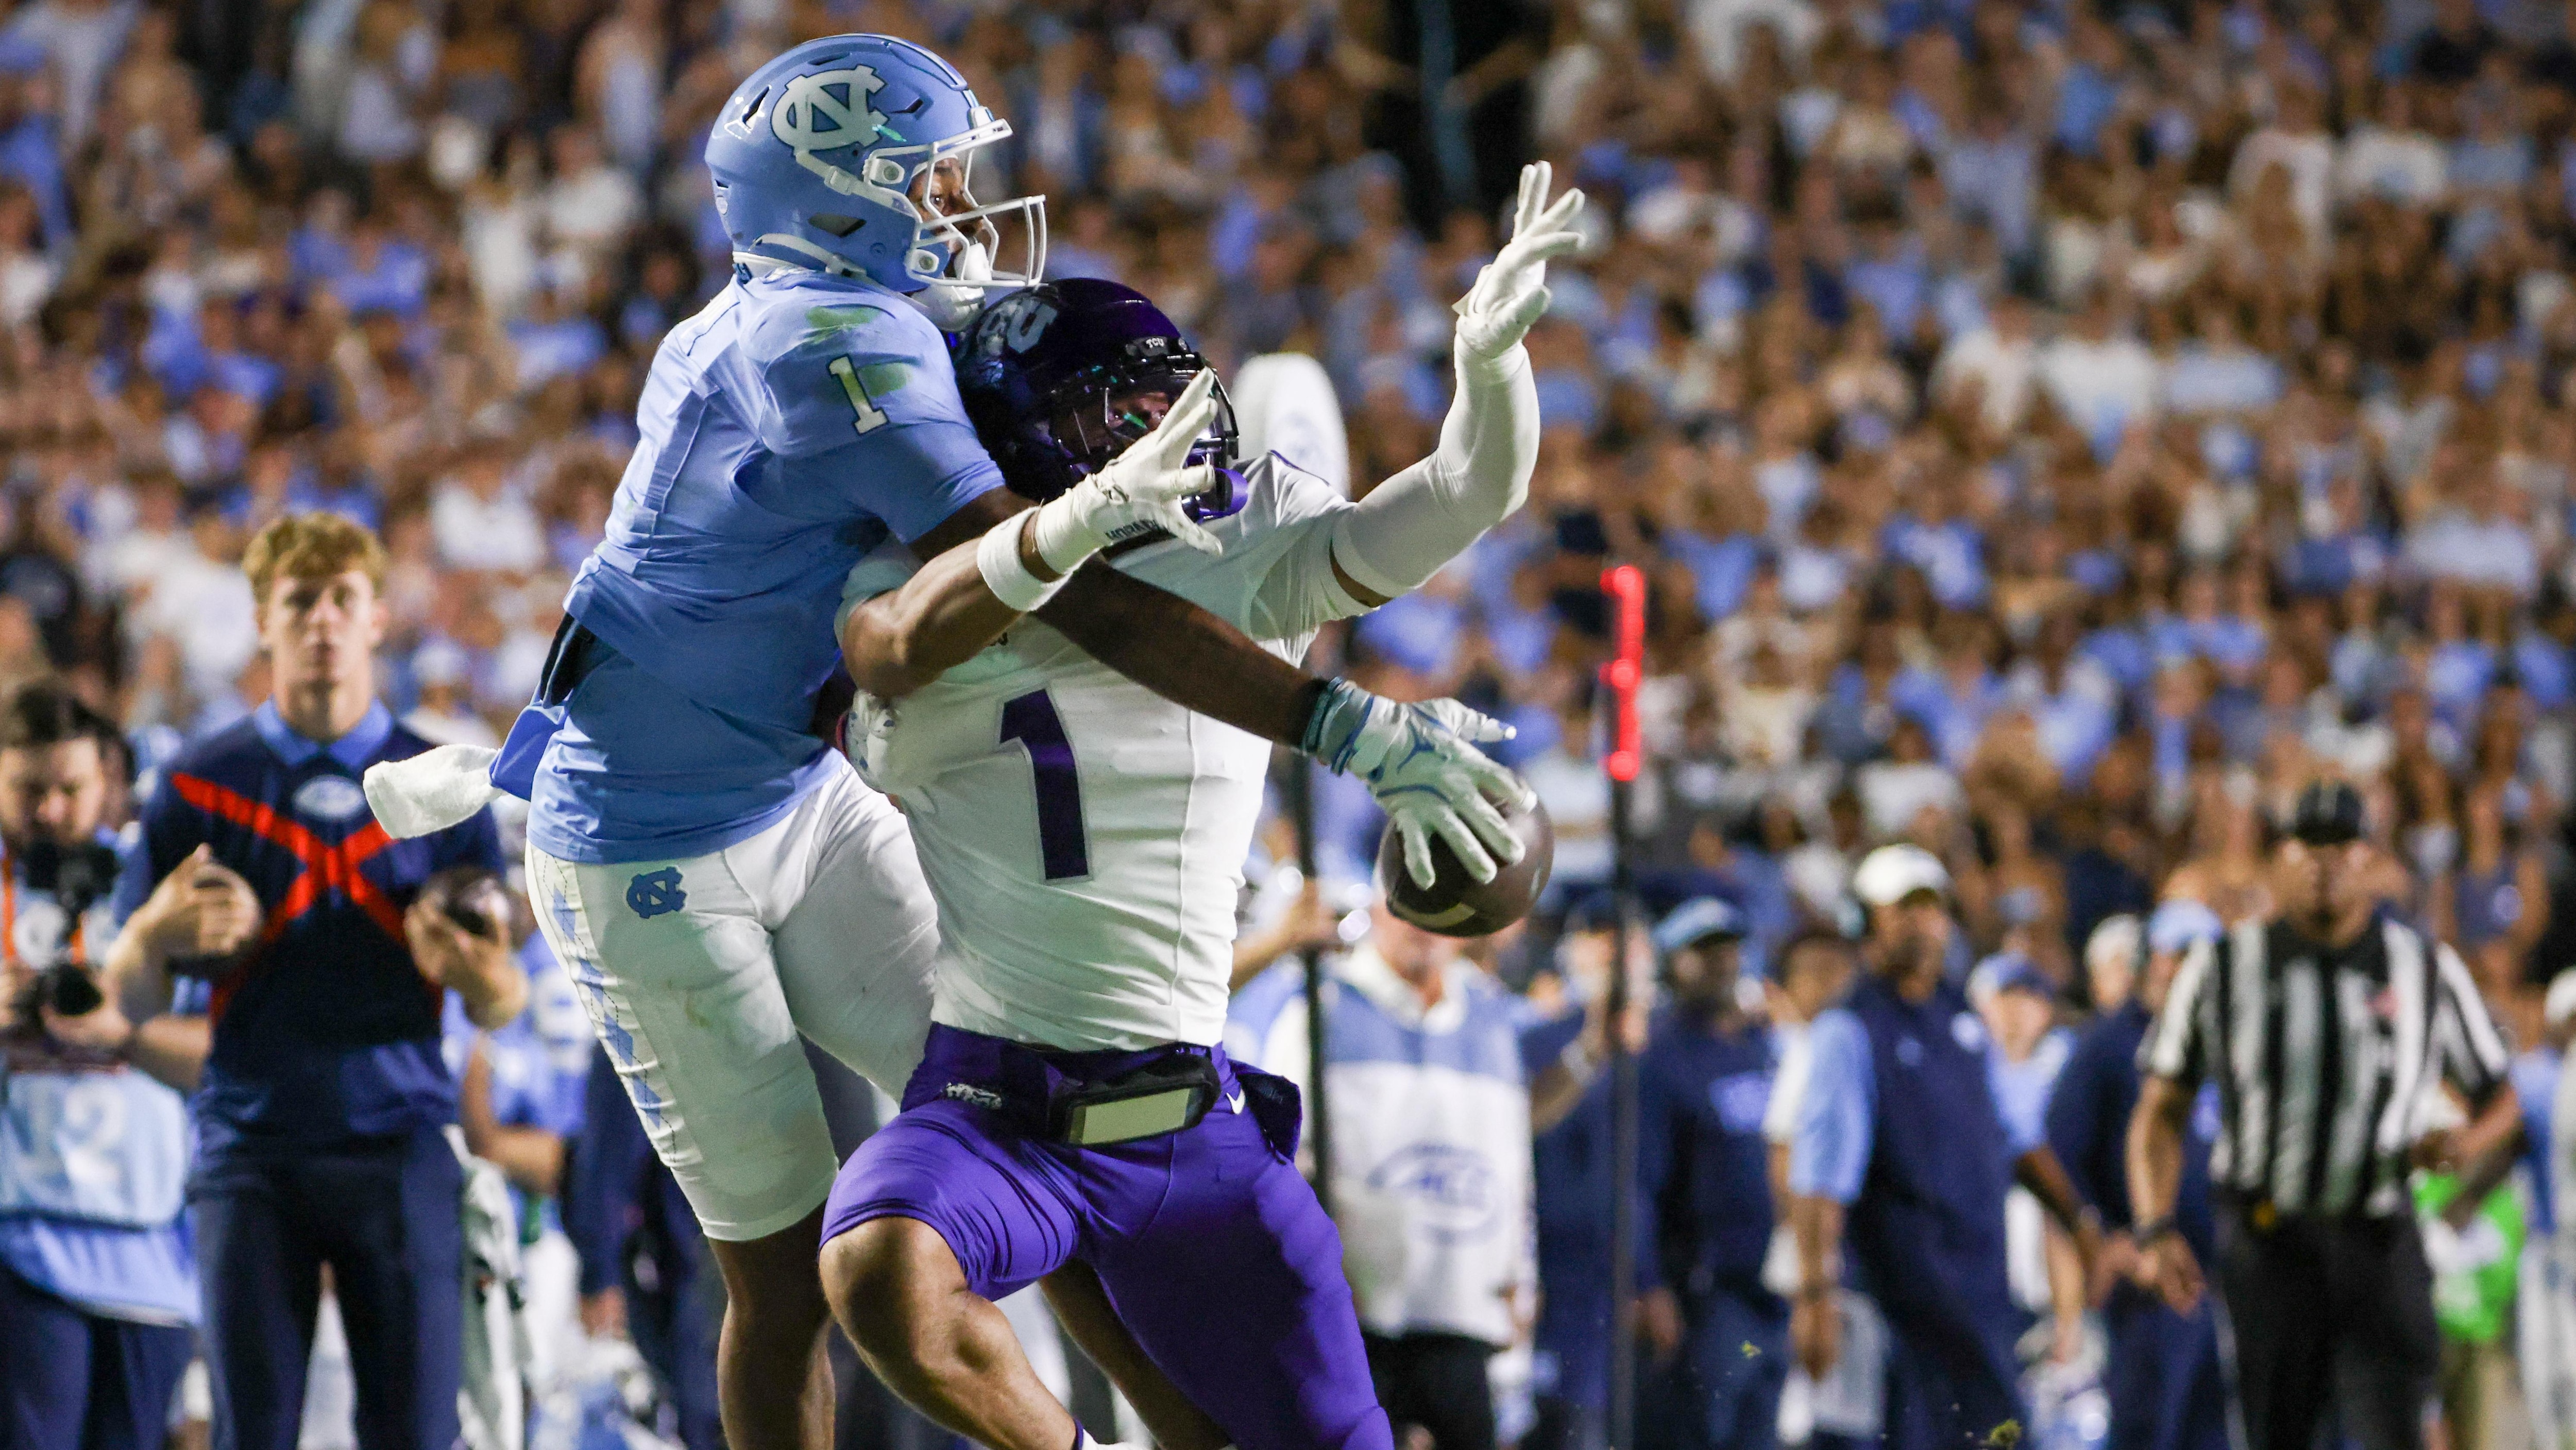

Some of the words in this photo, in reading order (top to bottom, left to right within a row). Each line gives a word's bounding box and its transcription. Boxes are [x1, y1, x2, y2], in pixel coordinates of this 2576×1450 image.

[1146, 338, 1164, 348] TCU
[829, 356, 890, 434] 1
[995, 685, 1093, 884] 1
